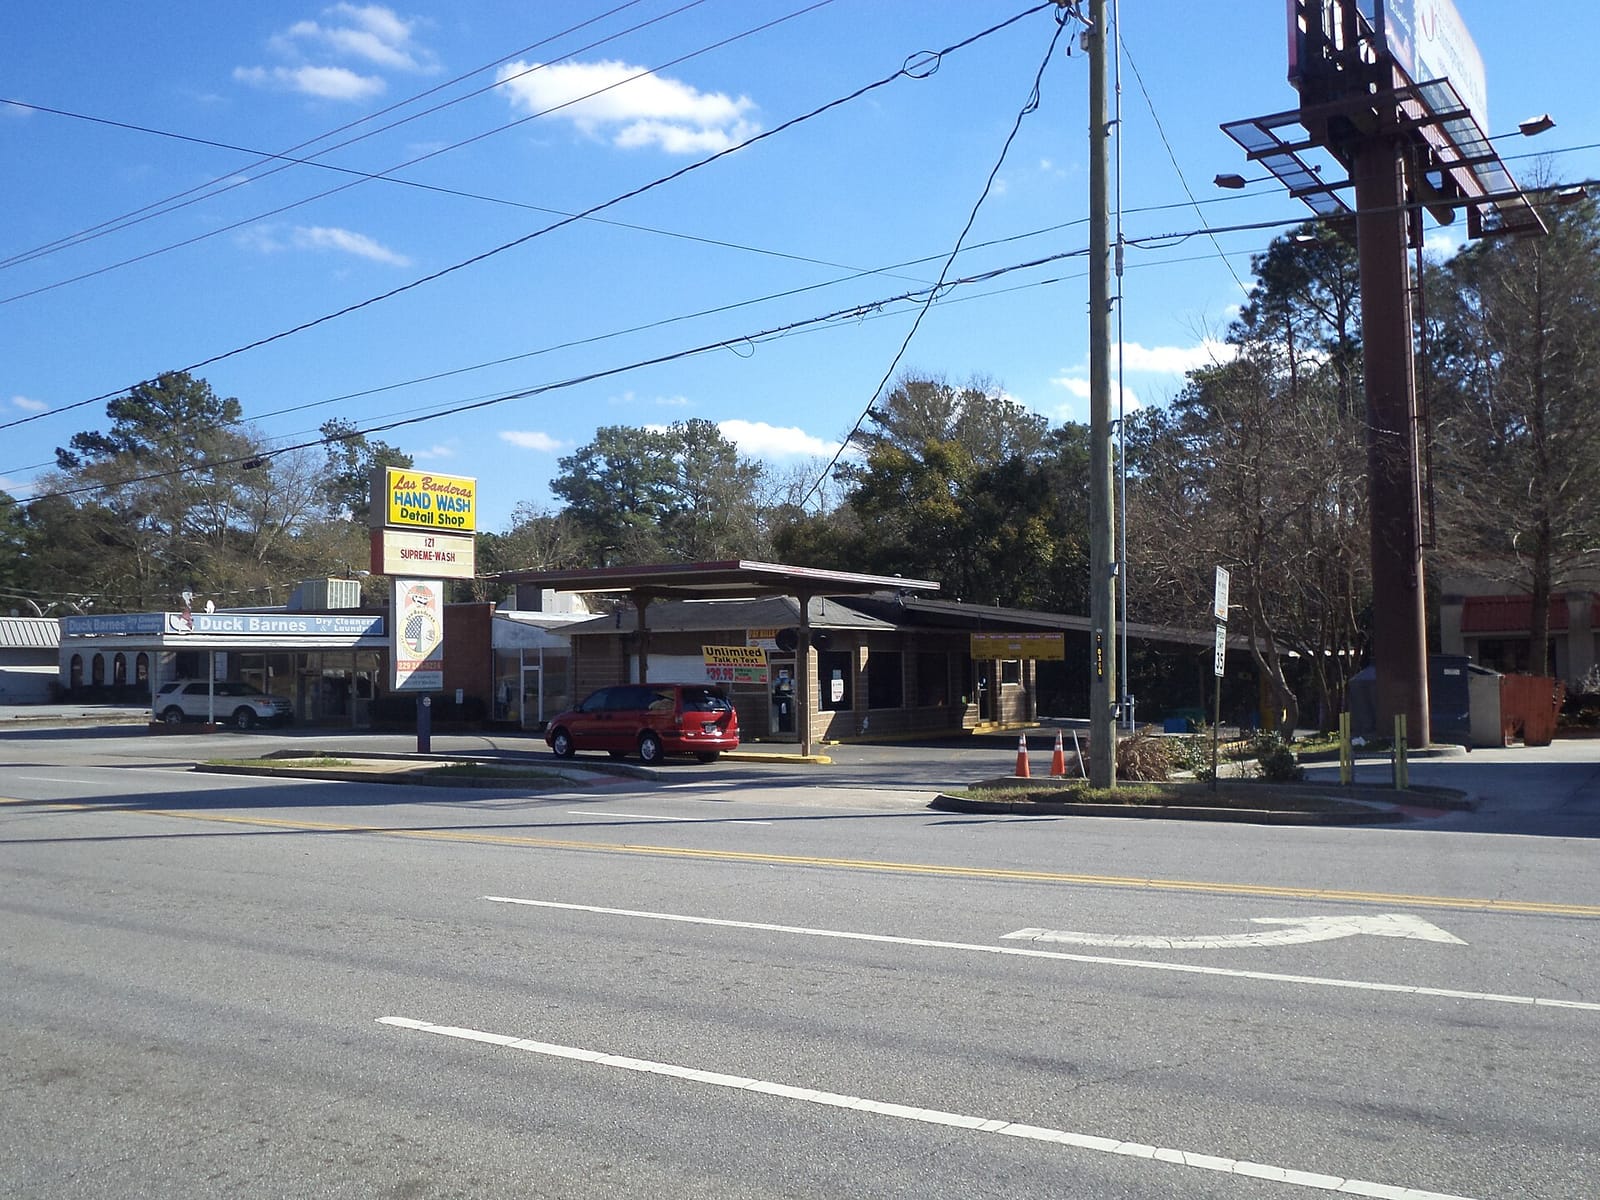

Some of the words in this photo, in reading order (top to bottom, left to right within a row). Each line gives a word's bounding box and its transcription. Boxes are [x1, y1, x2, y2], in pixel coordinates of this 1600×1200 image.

[393, 475, 417, 490] Las
[422, 477, 472, 497] Banderas
[394, 491, 431, 509] HAND
[436, 494, 470, 512] WASH
[400, 508, 433, 524] Detail
[438, 513, 464, 526] Shop
[400, 549, 455, 562] SUPREME-WASH
[68, 619, 93, 632] Duck
[200, 616, 243, 631] Duck
[249, 618, 307, 631] Barnes
[315, 618, 332, 626] Dry
[705, 647, 762, 657] Unlimited
[1216, 652, 1224, 670] 35
